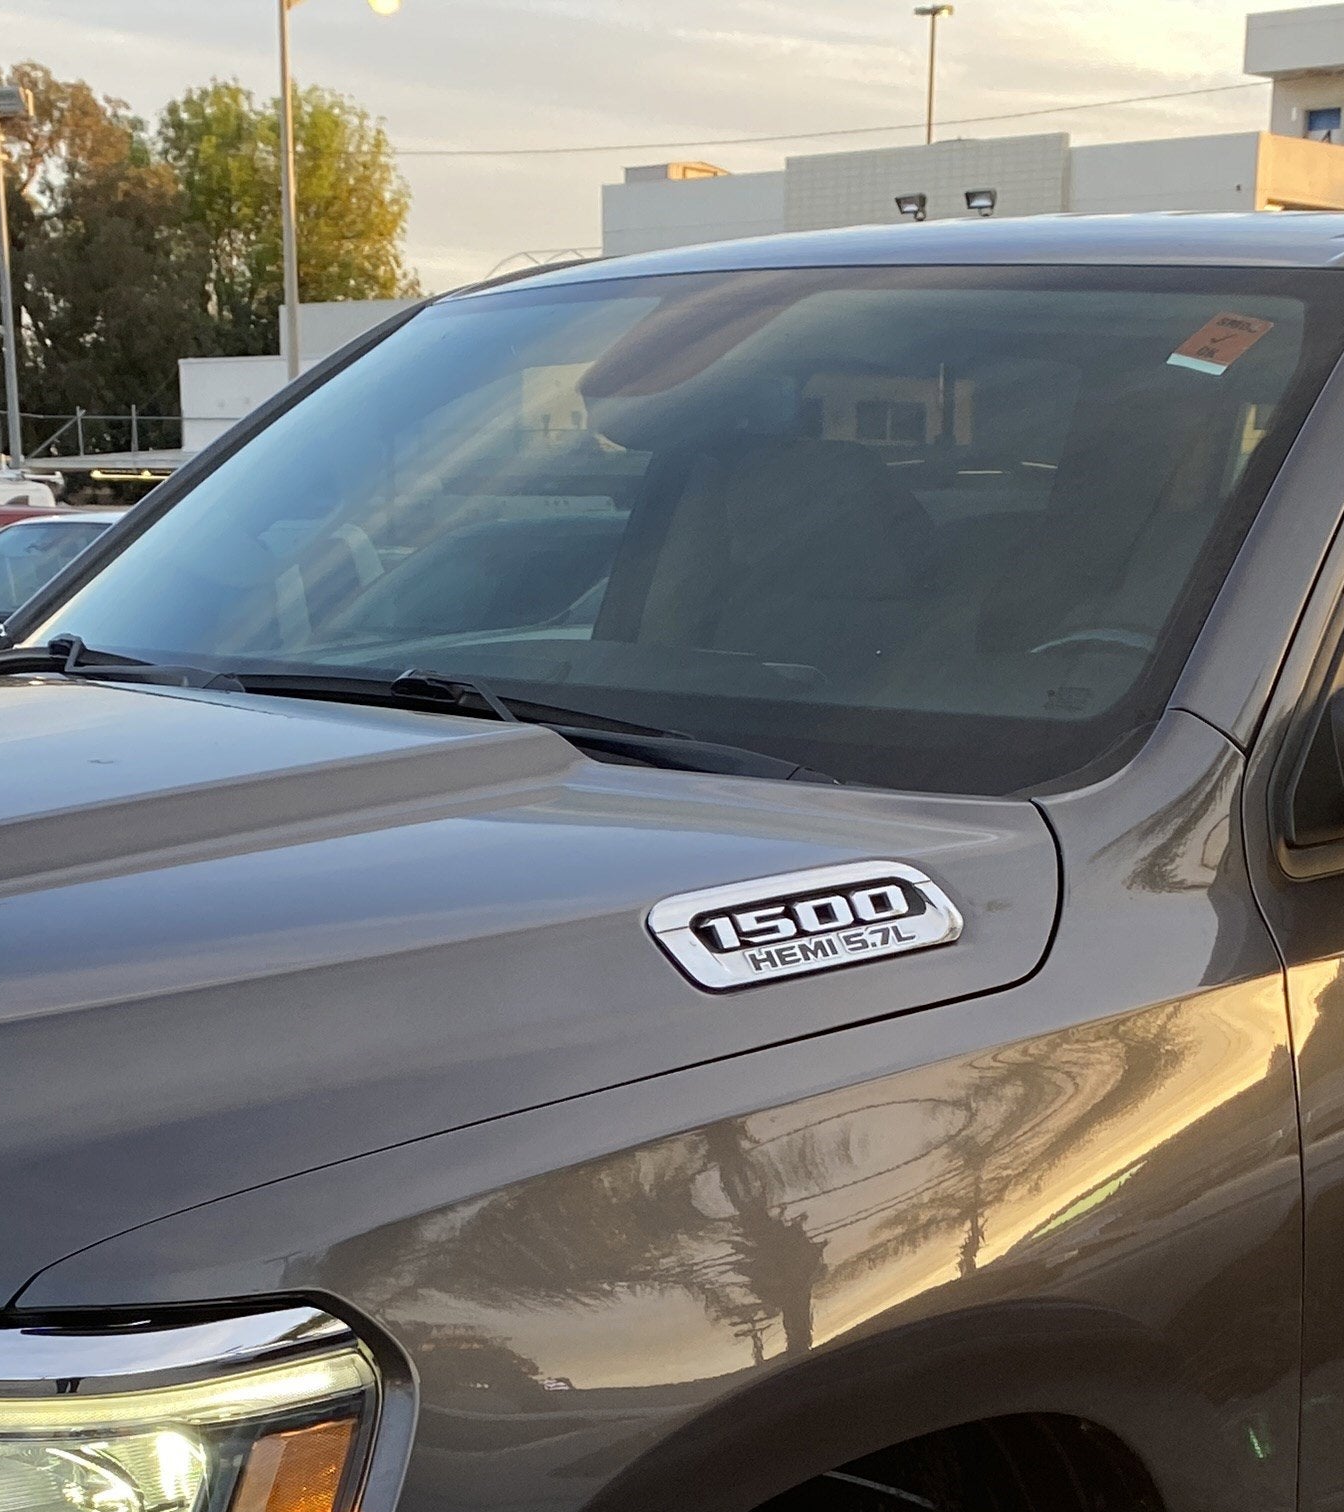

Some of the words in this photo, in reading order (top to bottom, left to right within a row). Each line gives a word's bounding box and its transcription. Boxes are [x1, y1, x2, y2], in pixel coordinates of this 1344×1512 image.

[701, 884, 909, 949] 1500
[746, 937, 839, 972] HEMI
[843, 925, 917, 953] 5.7L
